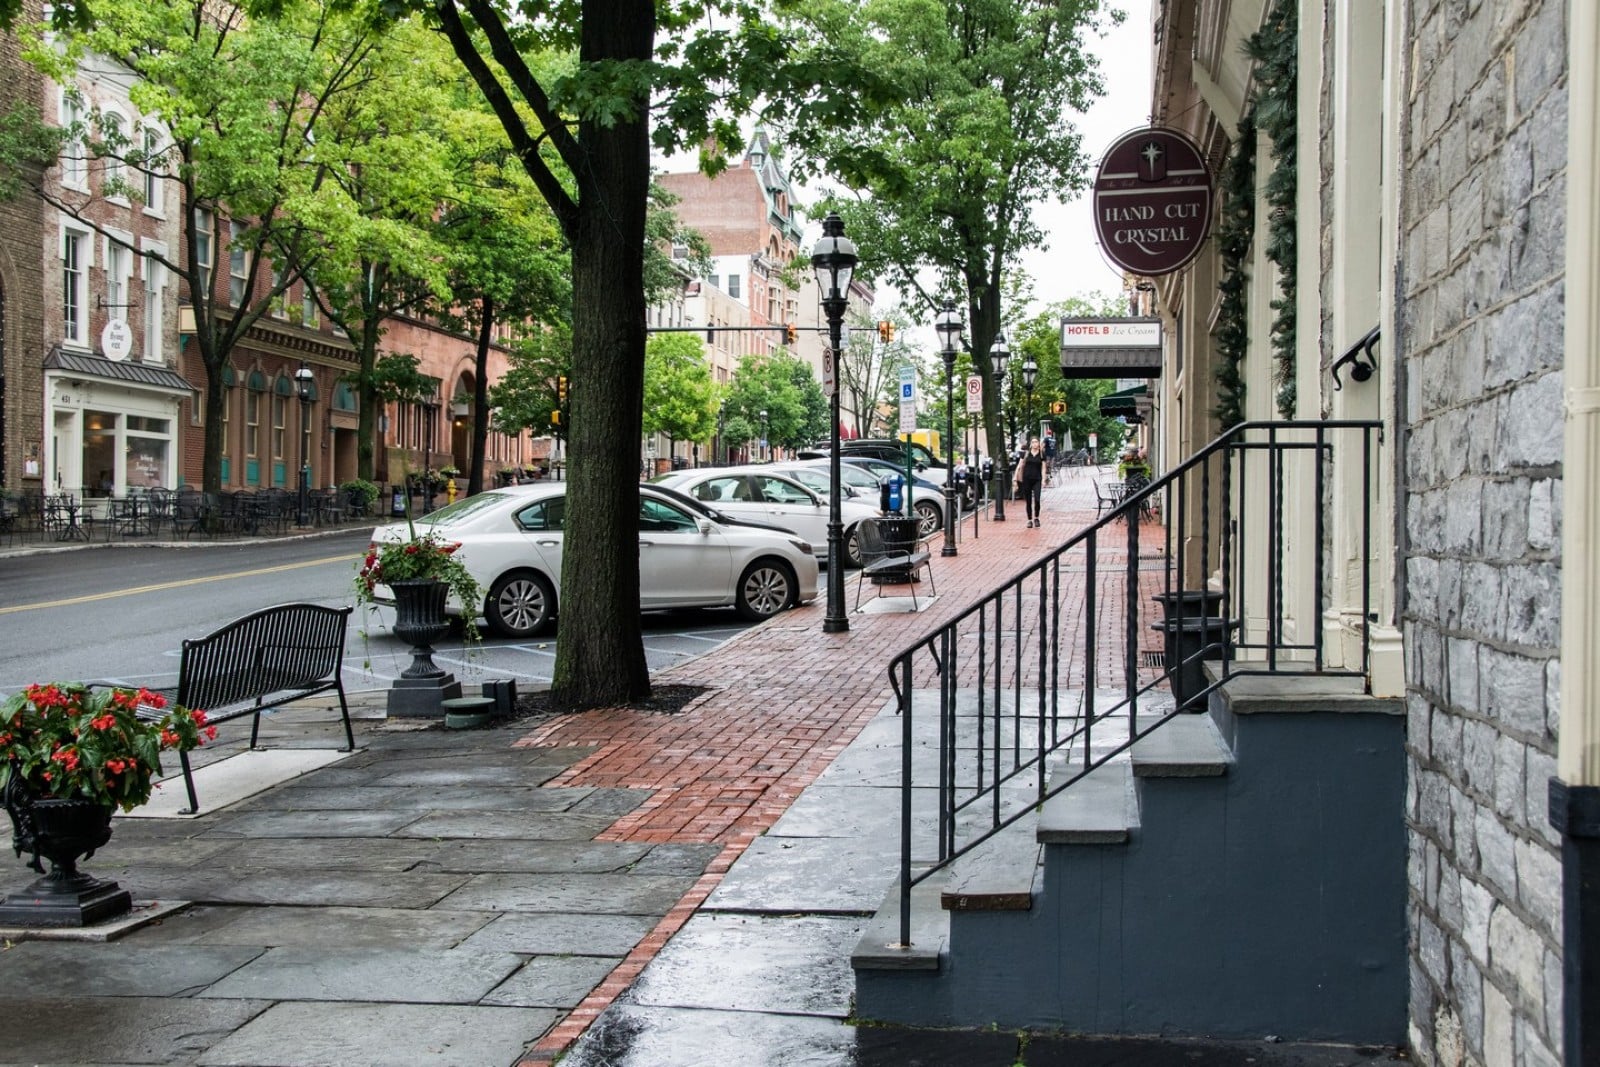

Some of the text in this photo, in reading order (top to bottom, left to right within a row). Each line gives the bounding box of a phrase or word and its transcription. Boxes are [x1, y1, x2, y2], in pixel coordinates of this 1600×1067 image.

[1105, 203, 1200, 222] HAND CUT
[1114, 226, 1190, 255] CRYSTAL
[1068, 326, 1156, 336] HOTEL B Ice Cream
[61, 395, 71, 404] 451
